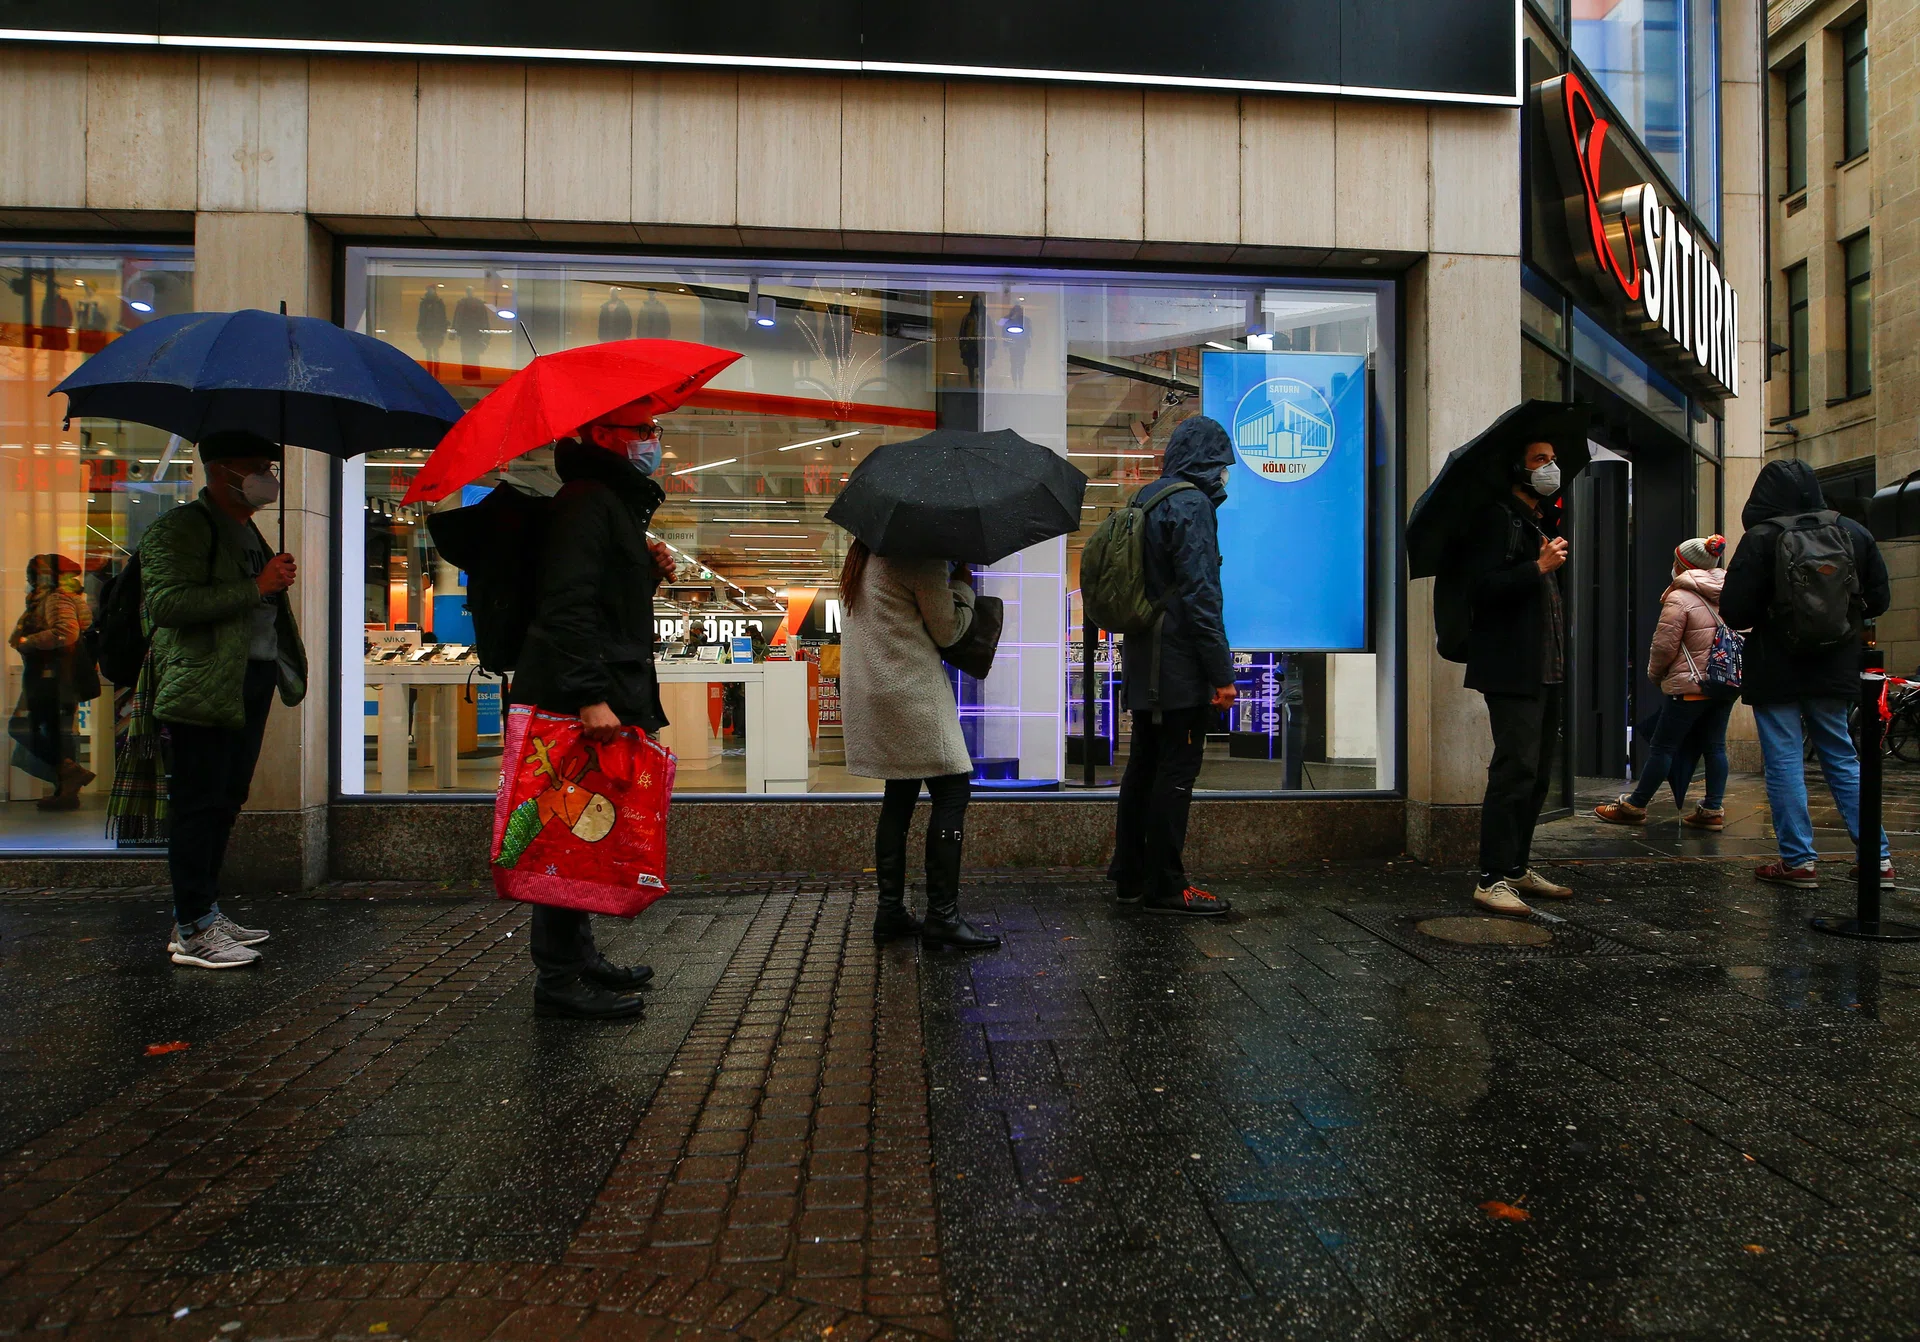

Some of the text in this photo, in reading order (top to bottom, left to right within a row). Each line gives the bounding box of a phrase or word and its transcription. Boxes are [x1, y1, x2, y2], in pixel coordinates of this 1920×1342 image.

[1643, 182, 1738, 398] SATURN
[1269, 384, 1300, 394] SATURN
[1262, 461, 1307, 474] KÖLN CITY
